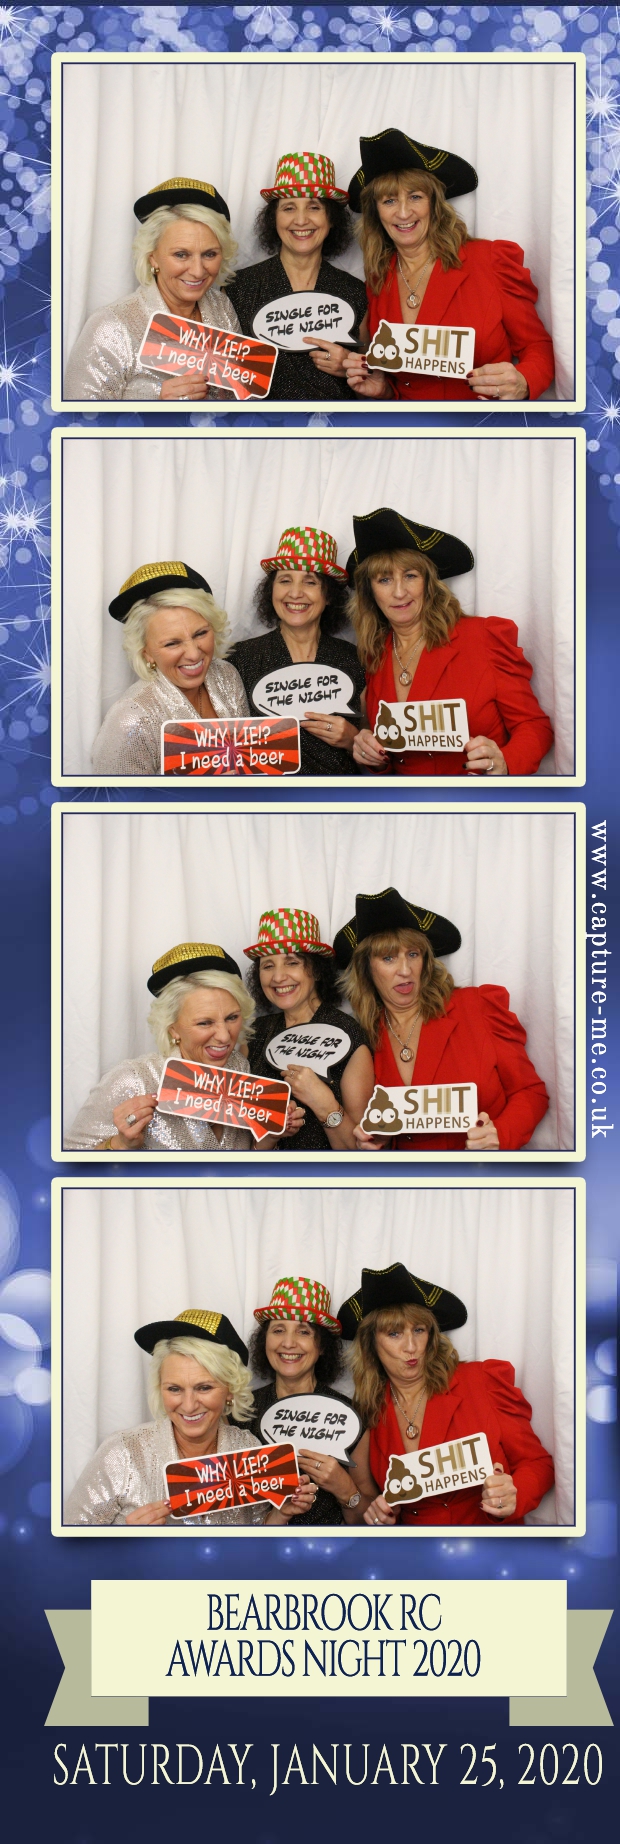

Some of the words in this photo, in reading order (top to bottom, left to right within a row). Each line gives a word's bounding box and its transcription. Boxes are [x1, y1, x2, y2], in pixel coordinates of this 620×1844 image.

[266, 306, 312, 322] SINGLE
[318, 304, 339, 316] FOR
[268, 324, 294, 337] THE
[300, 317, 342, 332] NIGHT
[179, 327, 210, 351] WHY
[213, 337, 250, 362] LIE!?
[404, 327, 469, 358] SHIT
[157, 343, 166, 360] I
[168, 349, 207, 371] need
[209, 362, 217, 375] a
[222, 365, 256, 385] beer
[406, 357, 465, 374] HAPPENS
[265, 677, 311, 693] SINGLE
[317, 675, 338, 687] FOR
[268, 694, 293, 707] THE
[299, 688, 341, 704] NIGHT
[404, 702, 460, 733] SHIT
[195, 727, 230, 747] WHY
[234, 726, 271, 746] LIE!?
[408, 734, 463, 747] HAPPENS
[180, 752, 186, 769] I
[192, 747, 229, 769] need
[236, 754, 243, 766] a
[250, 748, 284, 765] beer
[281, 1034, 318, 1045] SINGLE
[321, 1038, 342, 1048] FOR
[275, 1045, 293, 1055] THE
[298, 1046, 335, 1060] NIGHT
[194, 1071, 224, 1092] WHY
[228, 1079, 264, 1101] LIE!?
[174, 1088, 182, 1105] I
[185, 1095, 222, 1112] need
[226, 1103, 233, 1115] a
[239, 1102, 272, 1123] beer
[404, 1086, 471, 1115] SHIT
[406, 1116, 470, 1129] HAPPENS
[274, 1409, 321, 1423] SINGLE
[324, 1413, 347, 1426] FOR
[272, 1425, 297, 1437] THE
[300, 1427, 346, 1441] NIGHT
[419, 1437, 481, 1478] SHIT
[195, 1461, 227, 1483] WHY
[233, 1454, 269, 1478] LIE!?
[425, 1467, 487, 1492] HAPPENS
[185, 1490, 192, 1507] I
[197, 1480, 233, 1504] need
[239, 1484, 246, 1497] a
[251, 1476, 284, 1494] beer
